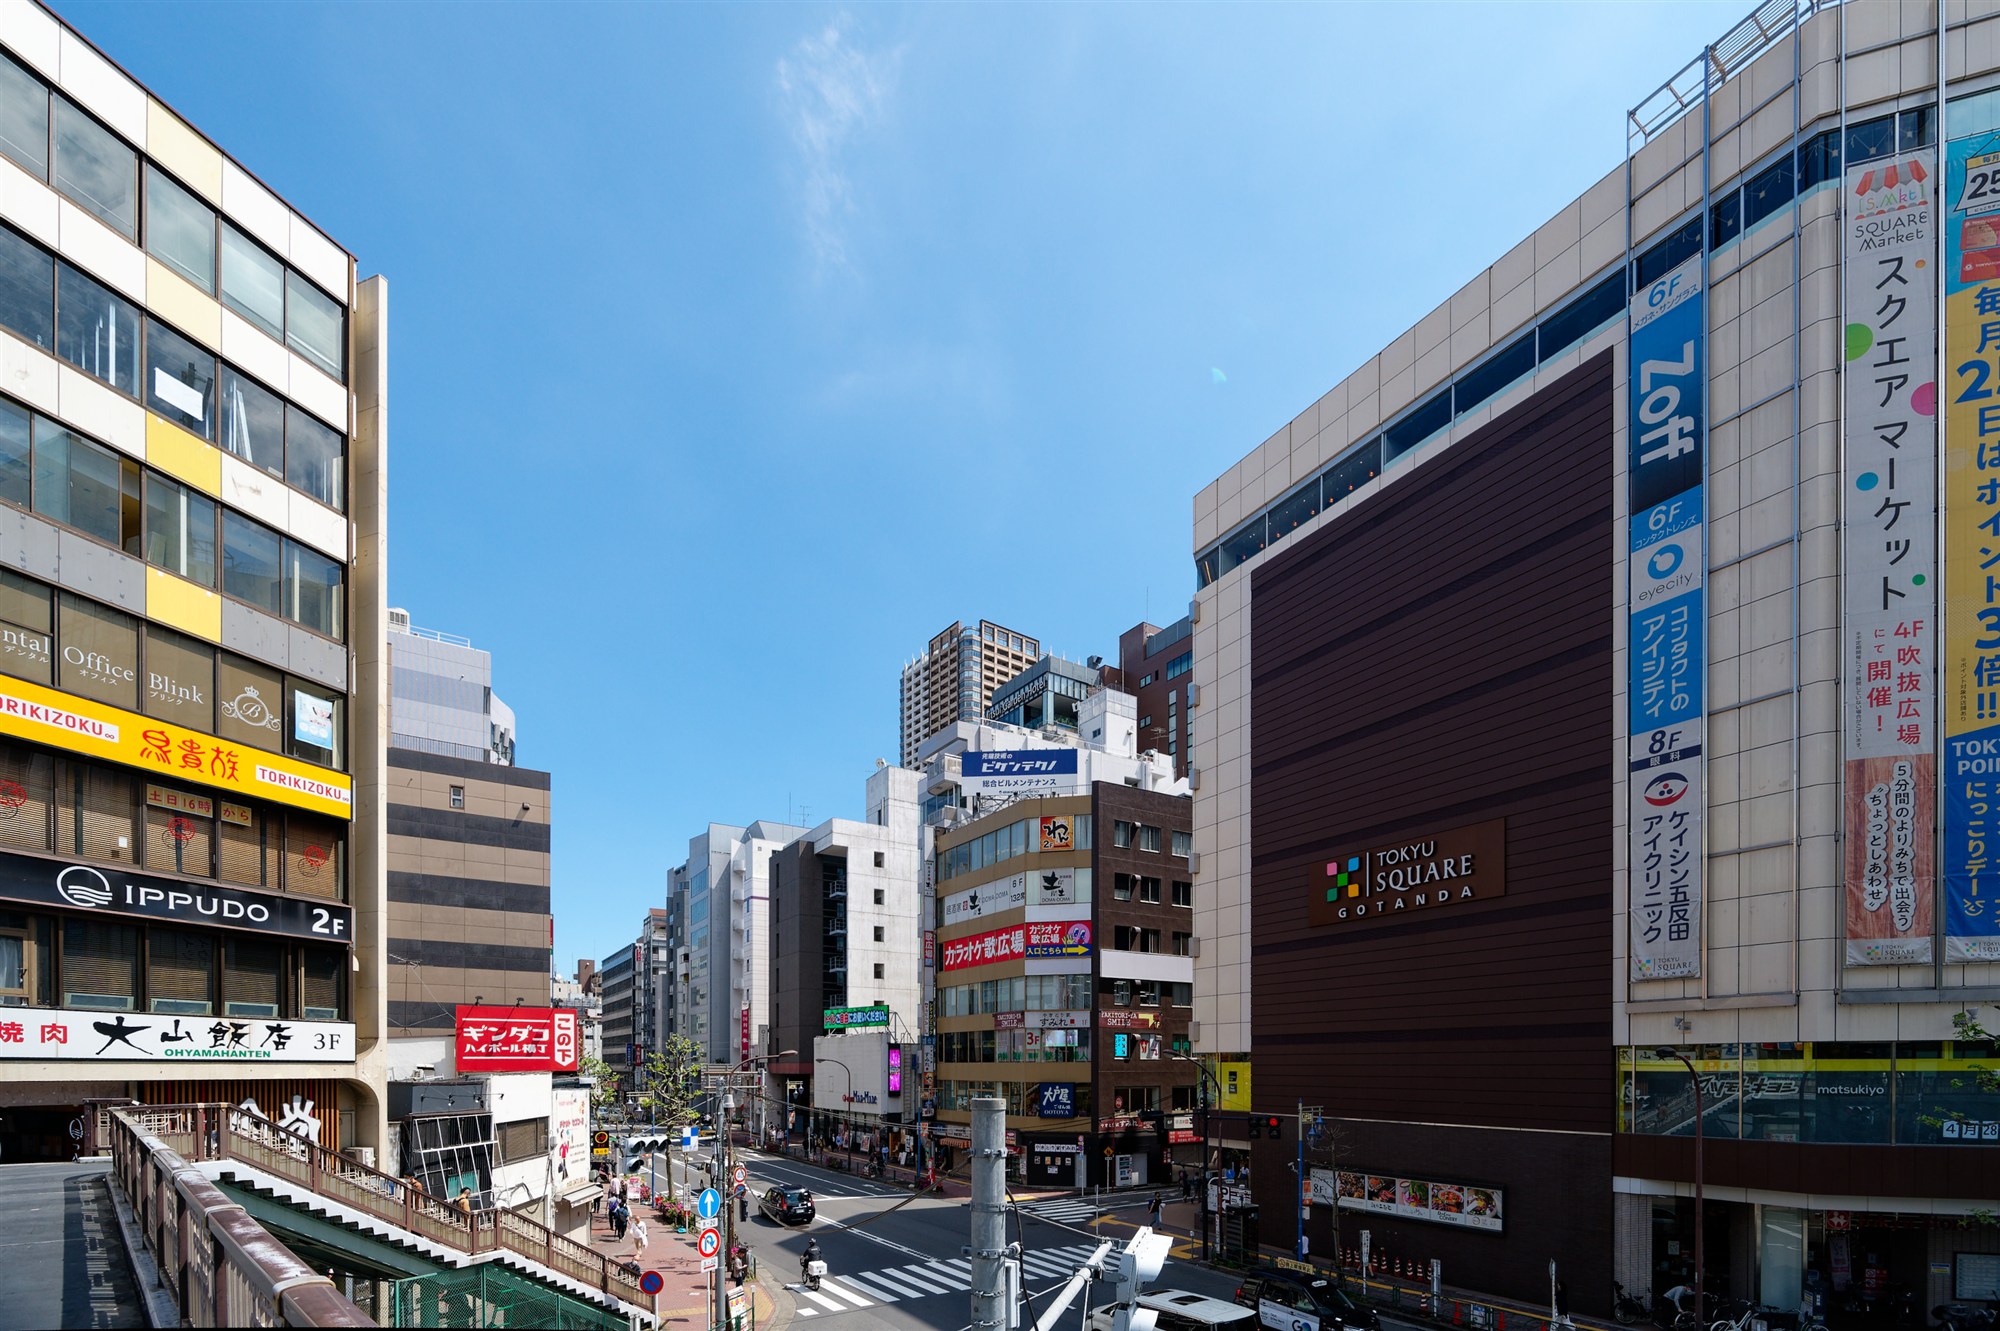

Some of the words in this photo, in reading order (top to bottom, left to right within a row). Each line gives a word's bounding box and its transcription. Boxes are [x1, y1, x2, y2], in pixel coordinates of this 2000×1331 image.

[1855, 211, 1928, 239] SQUARE
[1859, 228, 1924, 252] Market
[1648, 273, 1683, 307] 6F
[1633, 283, 1698, 331] メガネ・サングラス
[1639, 339, 1695, 465] Zoff
[1649, 501, 1683, 531] 6F
[1635, 514, 1697, 549] コンタクトレンズ
[1639, 572, 1693, 602] eyecity
[0, 628, 50, 655] ntal
[64, 646, 134, 681] Office
[149, 672, 204, 704] Blink
[1642, 613, 1665, 718] アイシティ
[1670, 605, 1689, 711] コンタクトの
[4, 645, 49, 663] デンタル
[80, 669, 118, 686] オフィス
[150, 690, 183, 706] ブリンク
[1648, 729, 1682, 755] 8F
[1952, 738, 2000, 757] TOK
[981, 761, 1057, 773] ビケンテクノ
[1650, 751, 1681, 767] 眼科
[259, 767, 342, 800] TORIKIZOKU
[982, 779, 1057, 788] 総合ビルメンテナンス
[149, 790, 211, 813] 土日16時
[223, 807, 249, 822] から
[1894, 765, 1910, 926] 5分間のよりみちで出会う
[1965, 782, 1988, 896] にっこりデー
[1377, 841, 1434, 866] TOKYU
[1376, 855, 1472, 892] SQUARE
[1643, 815, 1663, 944] アイクリニック
[1668, 811, 1690, 942] ケイシン五反田
[125, 885, 269, 922] IPPUDO
[1338, 886, 1472, 919] GOTANDA
[312, 909, 344, 934] 2F
[1029, 925, 1061, 934] カラオケ
[1027, 947, 1061, 955] 入口こちら
[1031, 935, 1060, 944] 歌広場
[1658, 961, 1692, 970] SQUARE
[1101, 1011, 1137, 1019] YAKITORI-YA
[0, 1022, 68, 1045] 焼肉
[93, 1016, 294, 1056] 大山飯店
[314, 1033, 341, 1050] 3F
[463, 1026, 549, 1041] ギンダコ
[557, 1017, 571, 1062] この下
[1027, 1032, 1040, 1045] 3F
[164, 1048, 271, 1058] OHYAMAHANTEN
[464, 1043, 548, 1054] ハイボール横丁
[1043, 1086, 1071, 1105] 大戸屋
[1817, 1084, 1885, 1096] matsukiyo
